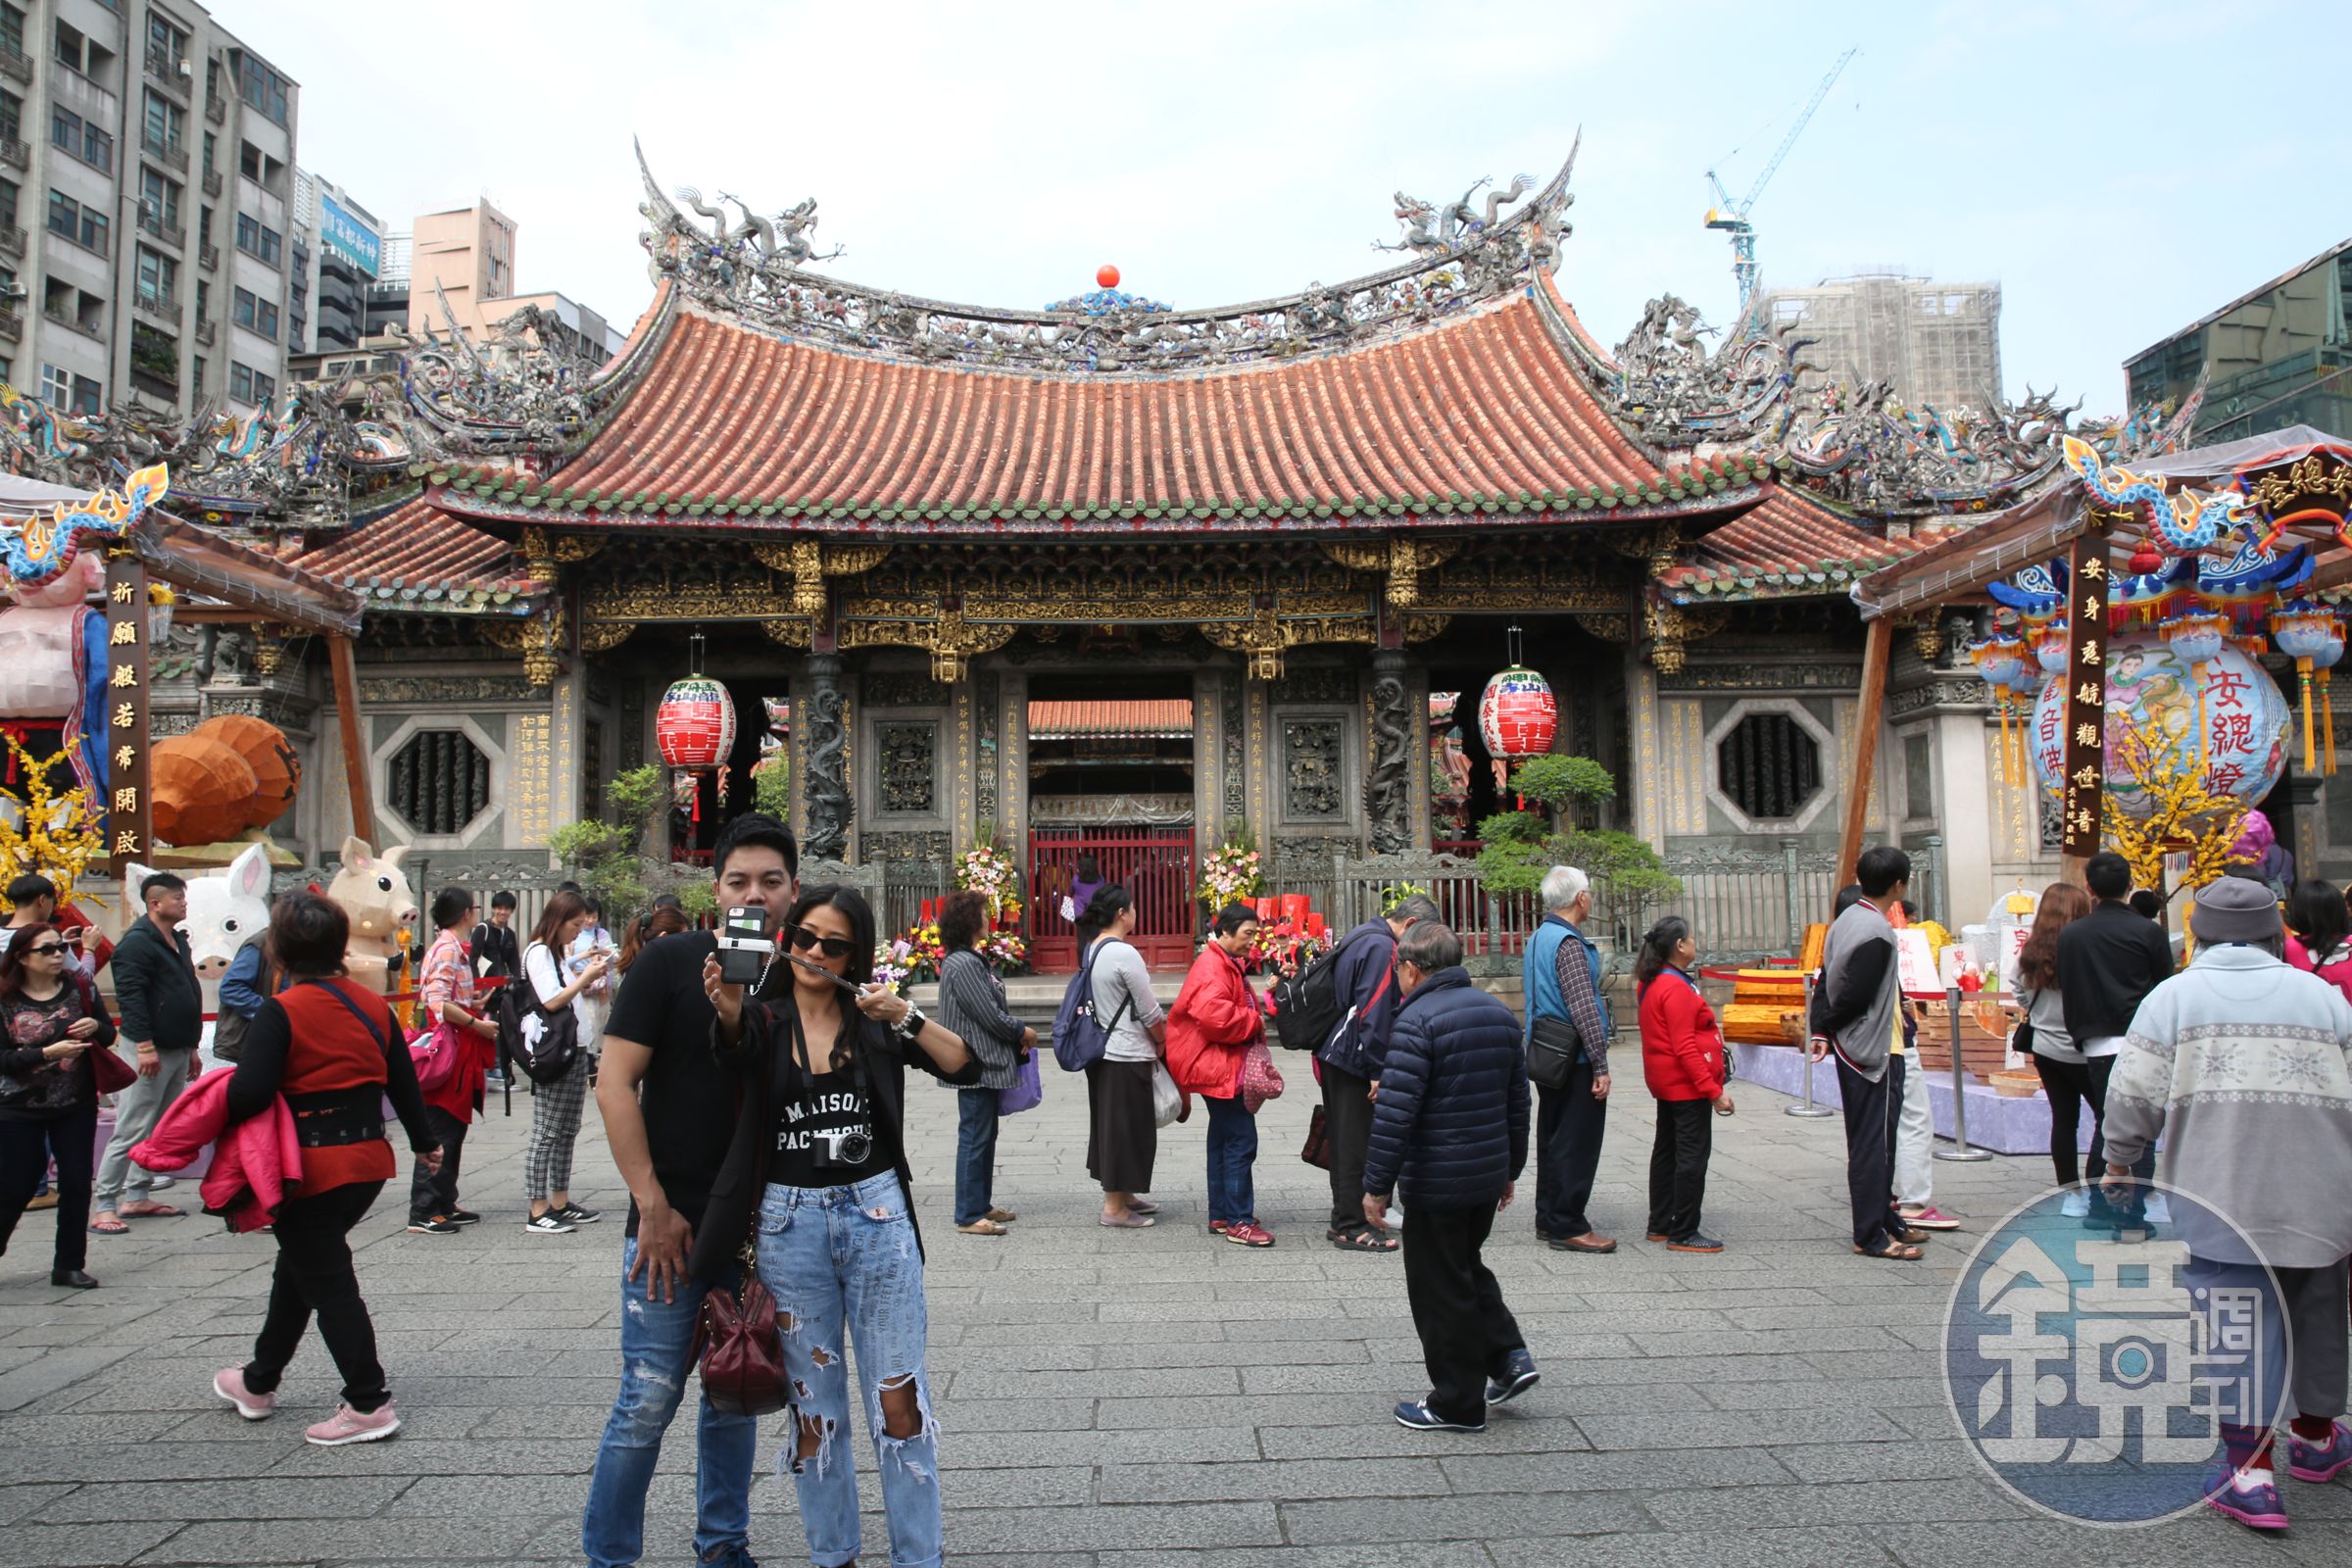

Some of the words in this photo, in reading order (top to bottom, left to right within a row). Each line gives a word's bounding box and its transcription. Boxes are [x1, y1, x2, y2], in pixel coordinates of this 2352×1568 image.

[2072, 557, 2105, 835] 安身慈航觀世音
[2205, 655, 2255, 799] 安總燈
[885, 1258, 900, 1280] NEXT
[880, 1285, 893, 1304] FEET
[877, 1308, 890, 1333] YOUR
